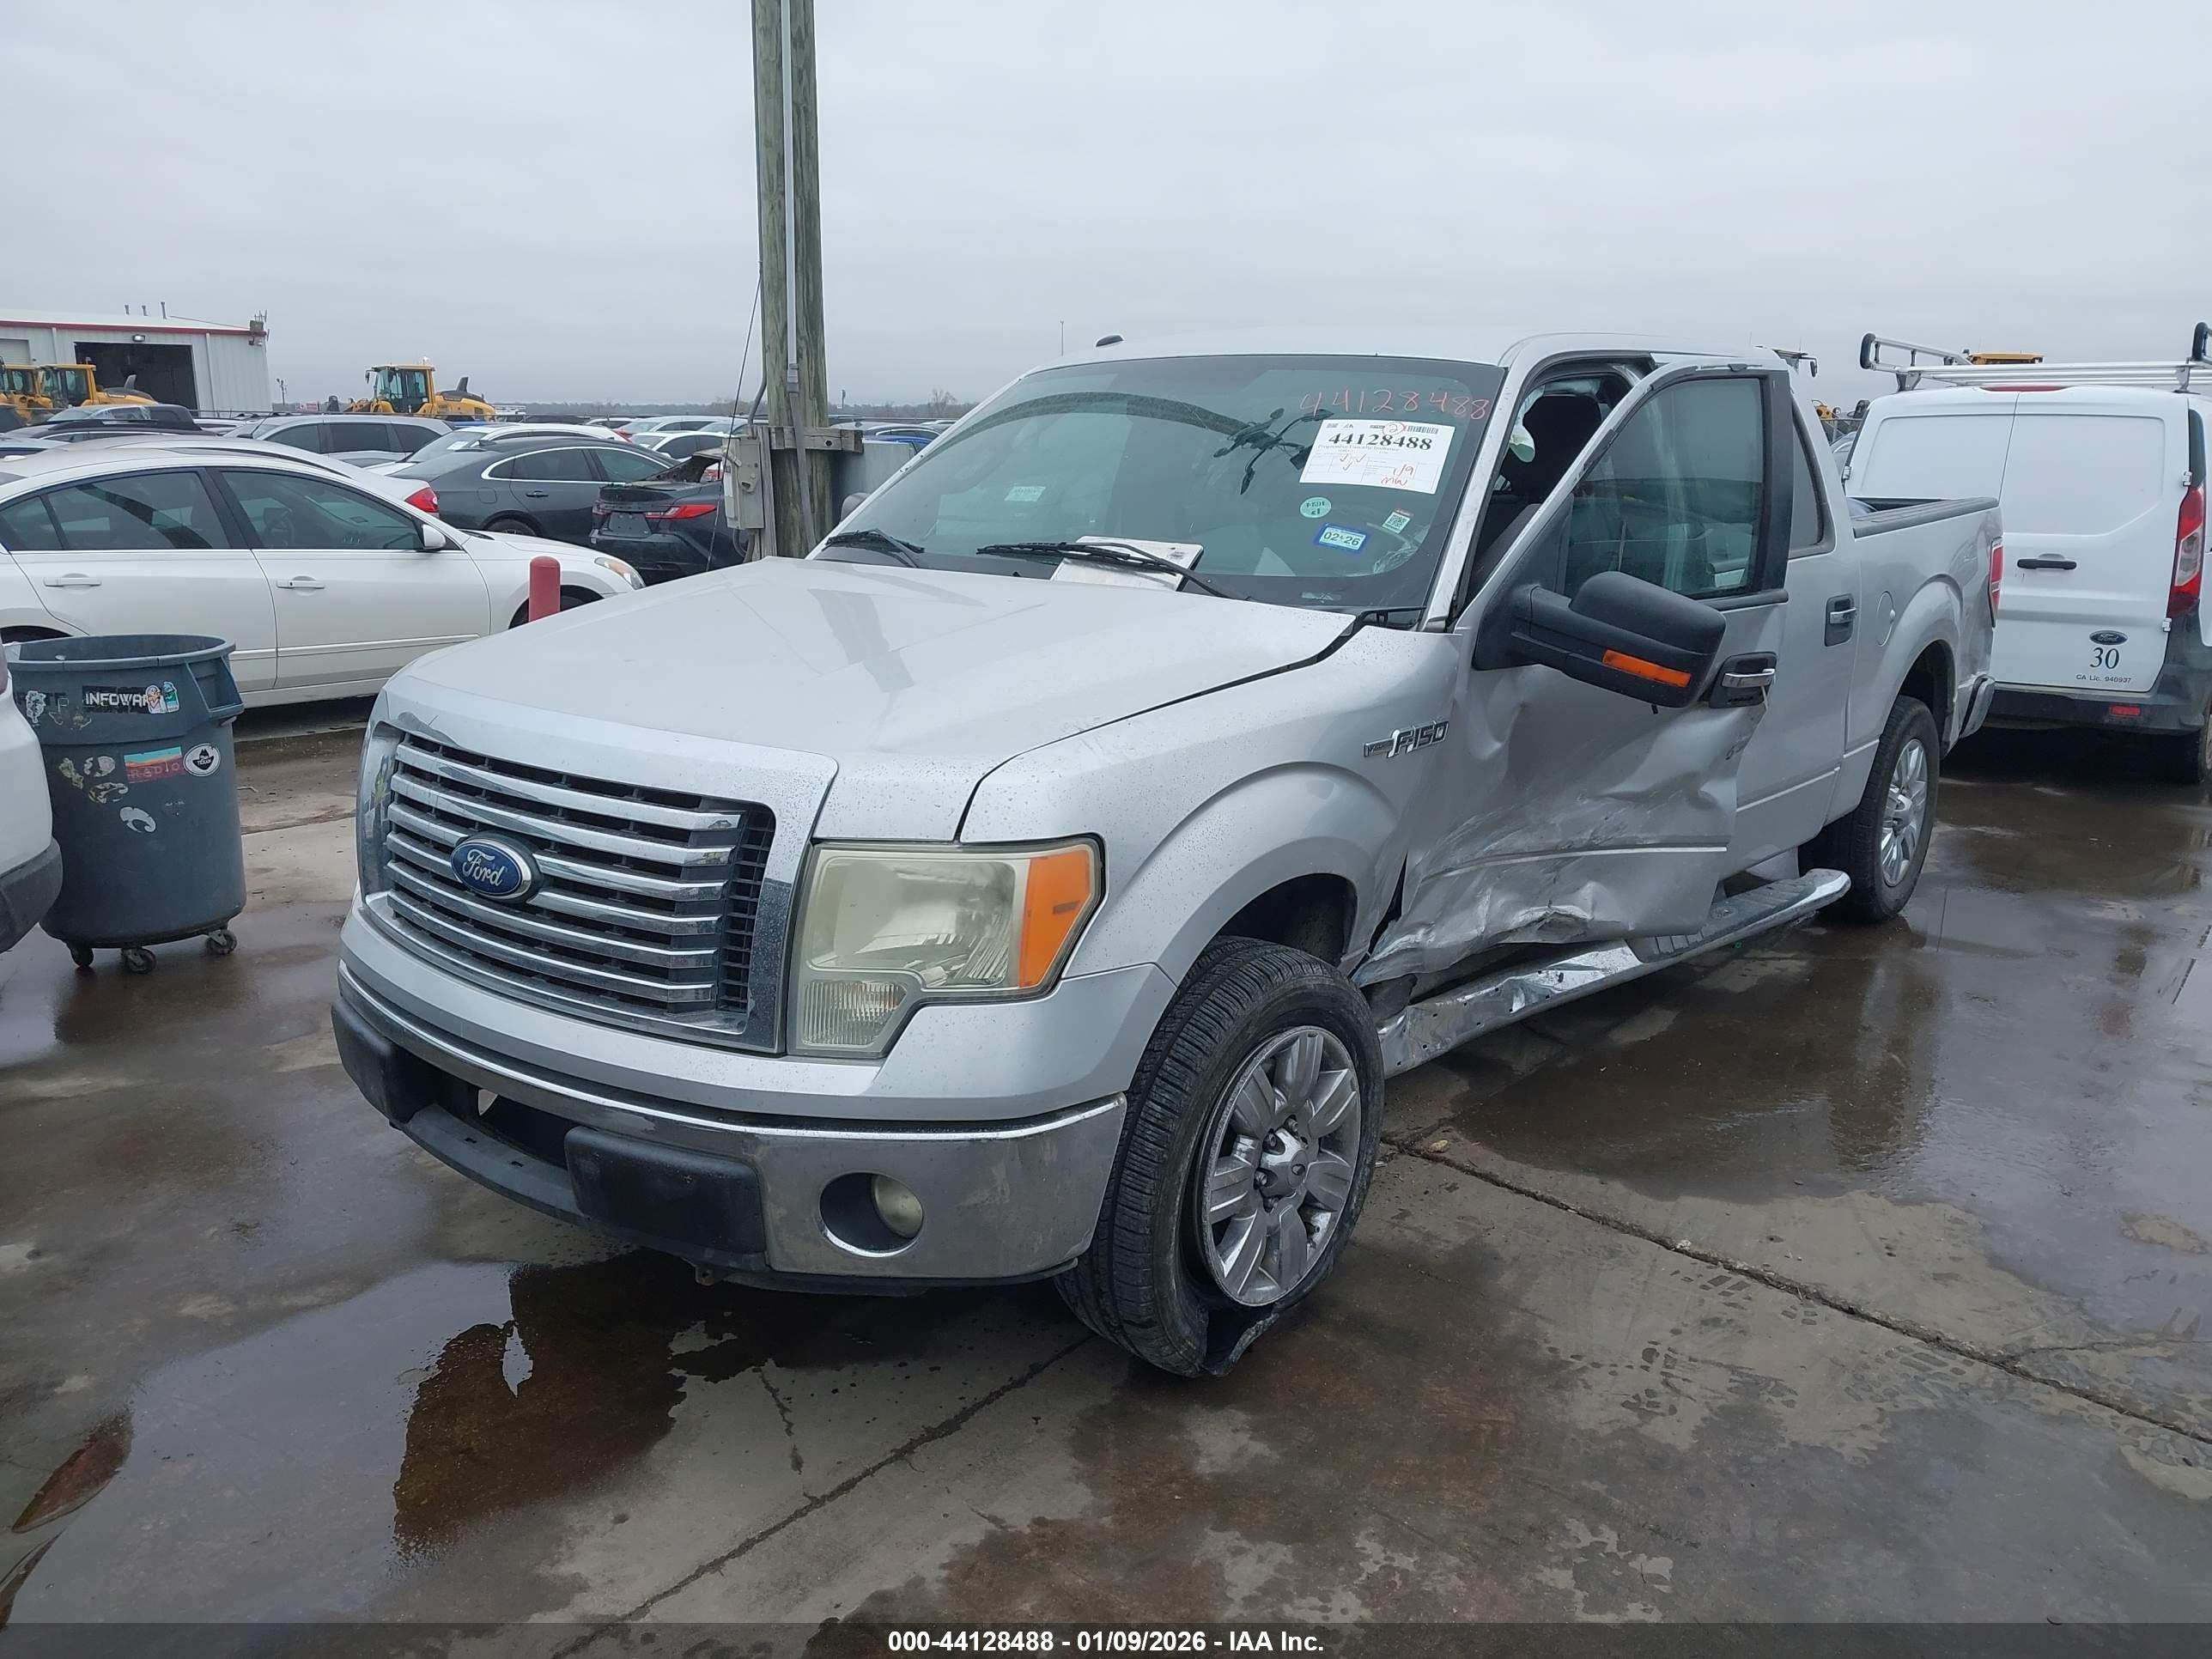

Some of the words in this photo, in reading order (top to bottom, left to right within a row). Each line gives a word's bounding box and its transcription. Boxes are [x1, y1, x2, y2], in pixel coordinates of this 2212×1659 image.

[1300, 389, 1490, 420] 44128488
[1328, 432, 1433, 451] 44128488
[1323, 531, 1339, 542] 02
[1343, 536, 1361, 547] 26
[2089, 647, 2120, 670] 30
[461, 848, 506, 886] Ford
